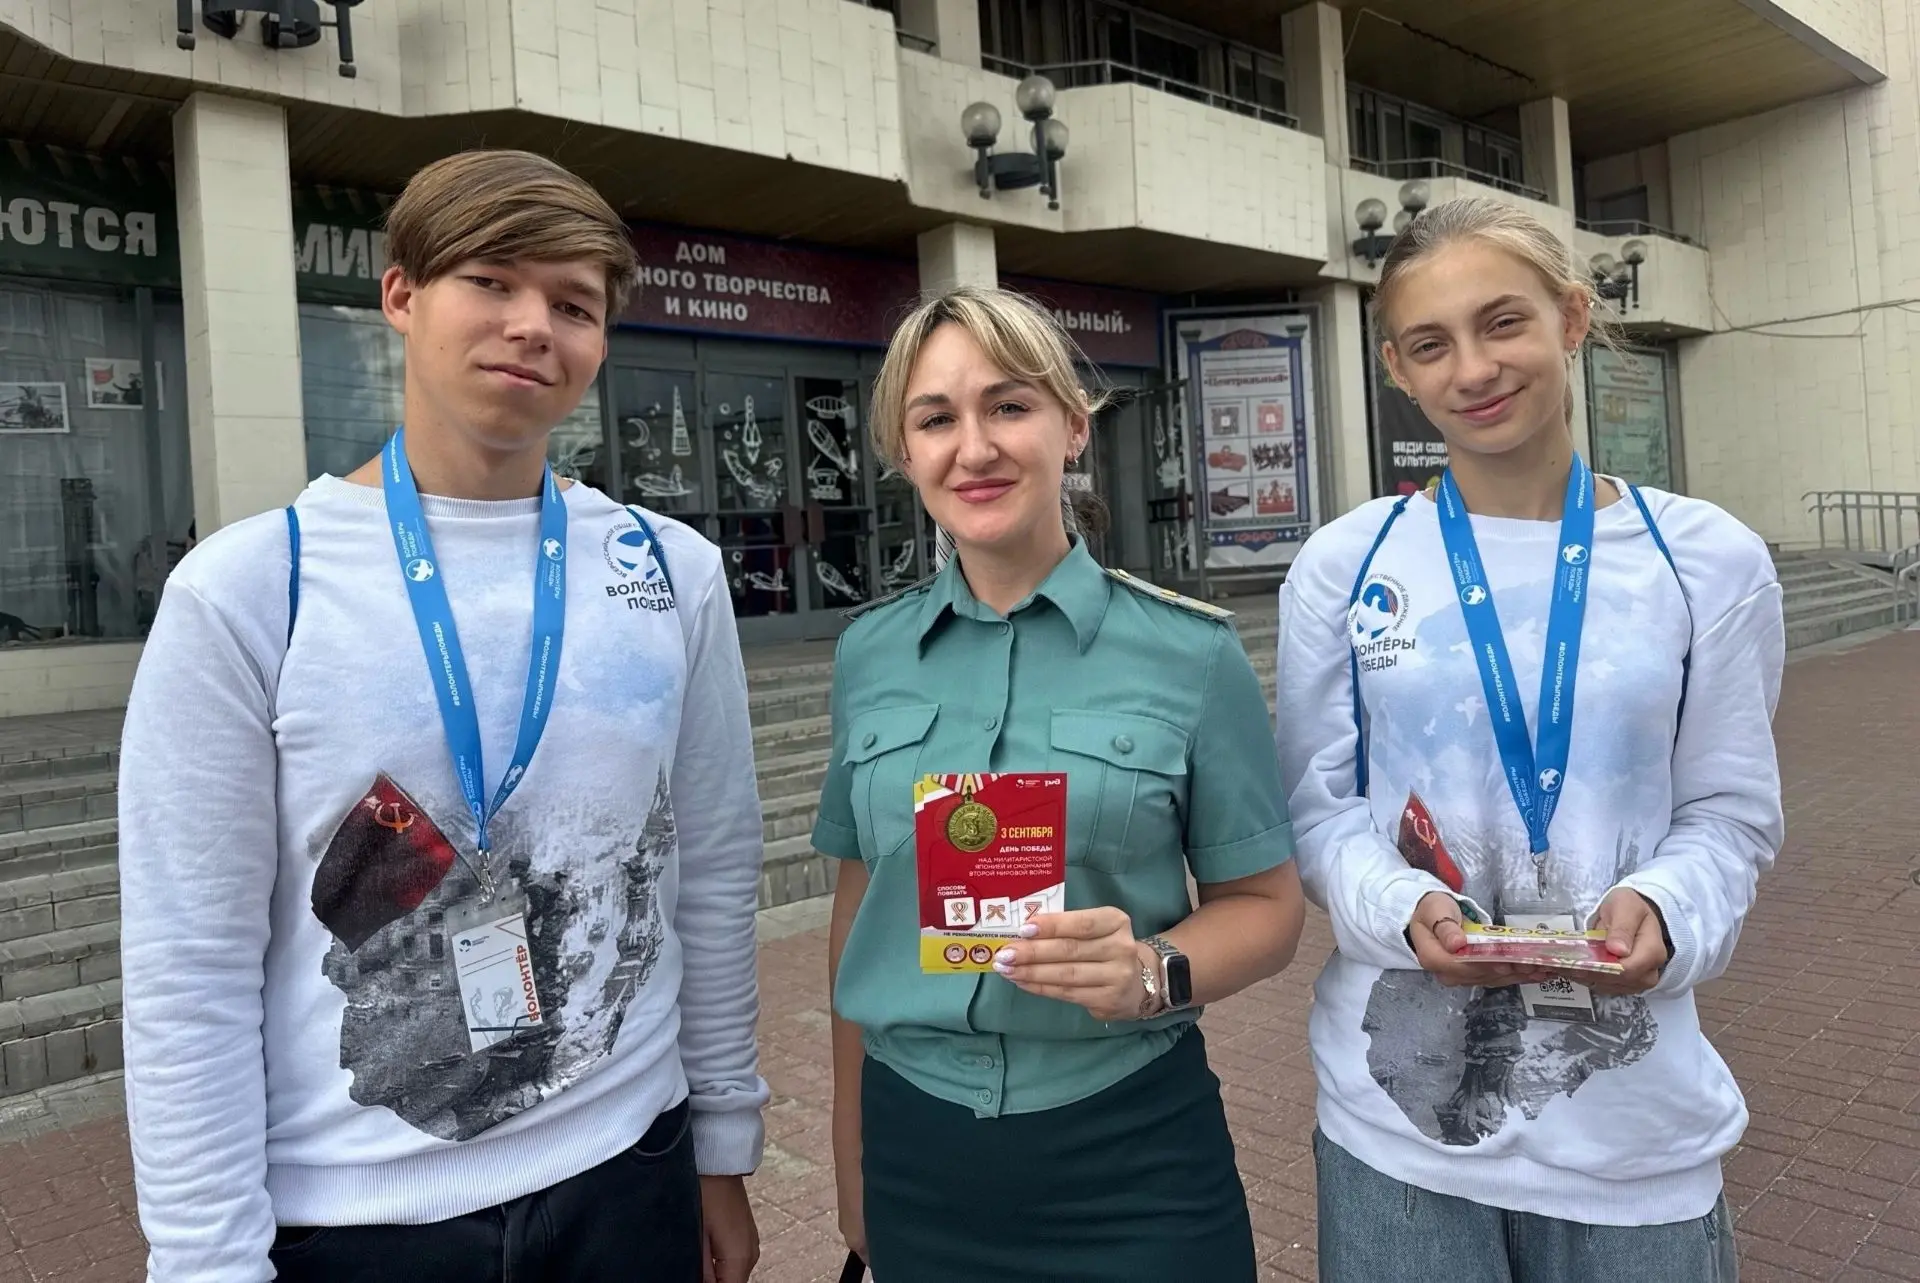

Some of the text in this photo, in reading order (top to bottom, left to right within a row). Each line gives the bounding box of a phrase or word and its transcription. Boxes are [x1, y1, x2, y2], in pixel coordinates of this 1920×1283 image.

[675, 241, 726, 265] ДОМ
[703, 272, 832, 305] ТВОРЧЕСТВА
[665, 295, 749, 322] И КИНО
[1393, 441, 1423, 455] ВЕДИ
[1000, 826, 1053, 839] 3 СЕНТЯБРЯ
[1000, 845, 1019, 853] ДЕНЬ
[969, 869, 995, 877] ВТОРОЙ
[1029, 868, 1053, 876] ВОЙНЫ
[975, 862, 1006, 870] ЯПОНИЕЙ
[516, 945, 540, 1022] ВОЛОНТЁР
